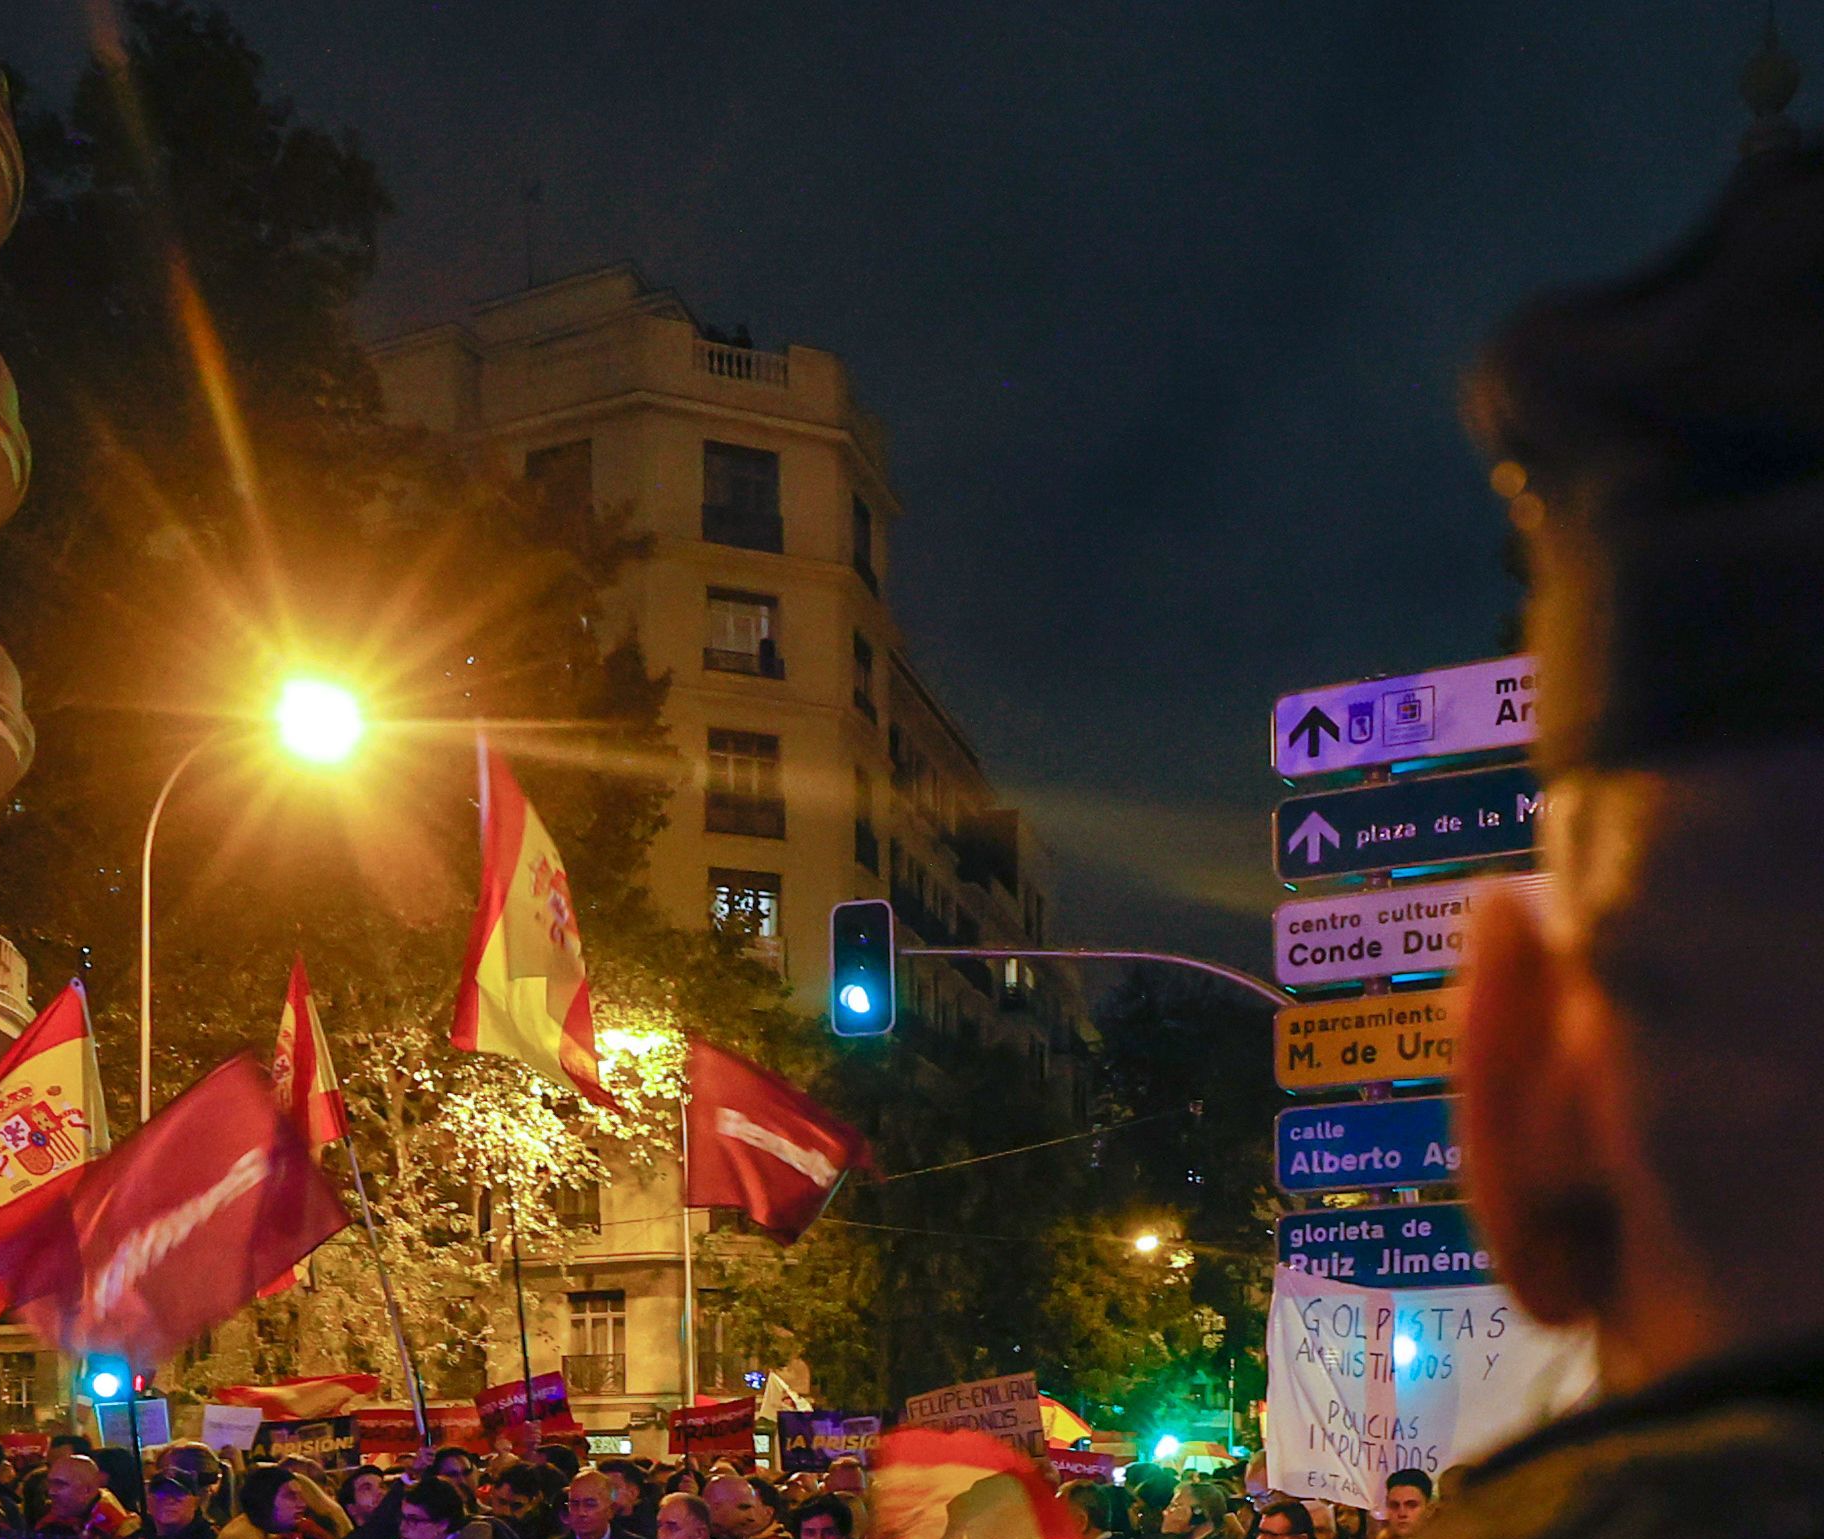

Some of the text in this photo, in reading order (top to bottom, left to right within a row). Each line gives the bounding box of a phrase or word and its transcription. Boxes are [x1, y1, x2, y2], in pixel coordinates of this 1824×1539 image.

[1495, 673, 1540, 695] me
[1495, 698, 1538, 726] Ar
[1356, 790, 1554, 848] plaza de la M
[1289, 896, 1472, 936] centro cultural
[1288, 929, 1464, 967] Conde Duq
[1289, 1005, 1448, 1038] aparcamiento
[1289, 1033, 1456, 1070] M. de Urq
[1289, 1121, 1345, 1142] calle
[1289, 1141, 1463, 1176] Alberto Ag
[1289, 1218, 1433, 1248] glorieta de
[1289, 1245, 1497, 1278] Ruiz Jiméne
[1303, 1298, 1509, 1341] GOLPISTAS
[1483, 1353, 1499, 1381] Y
